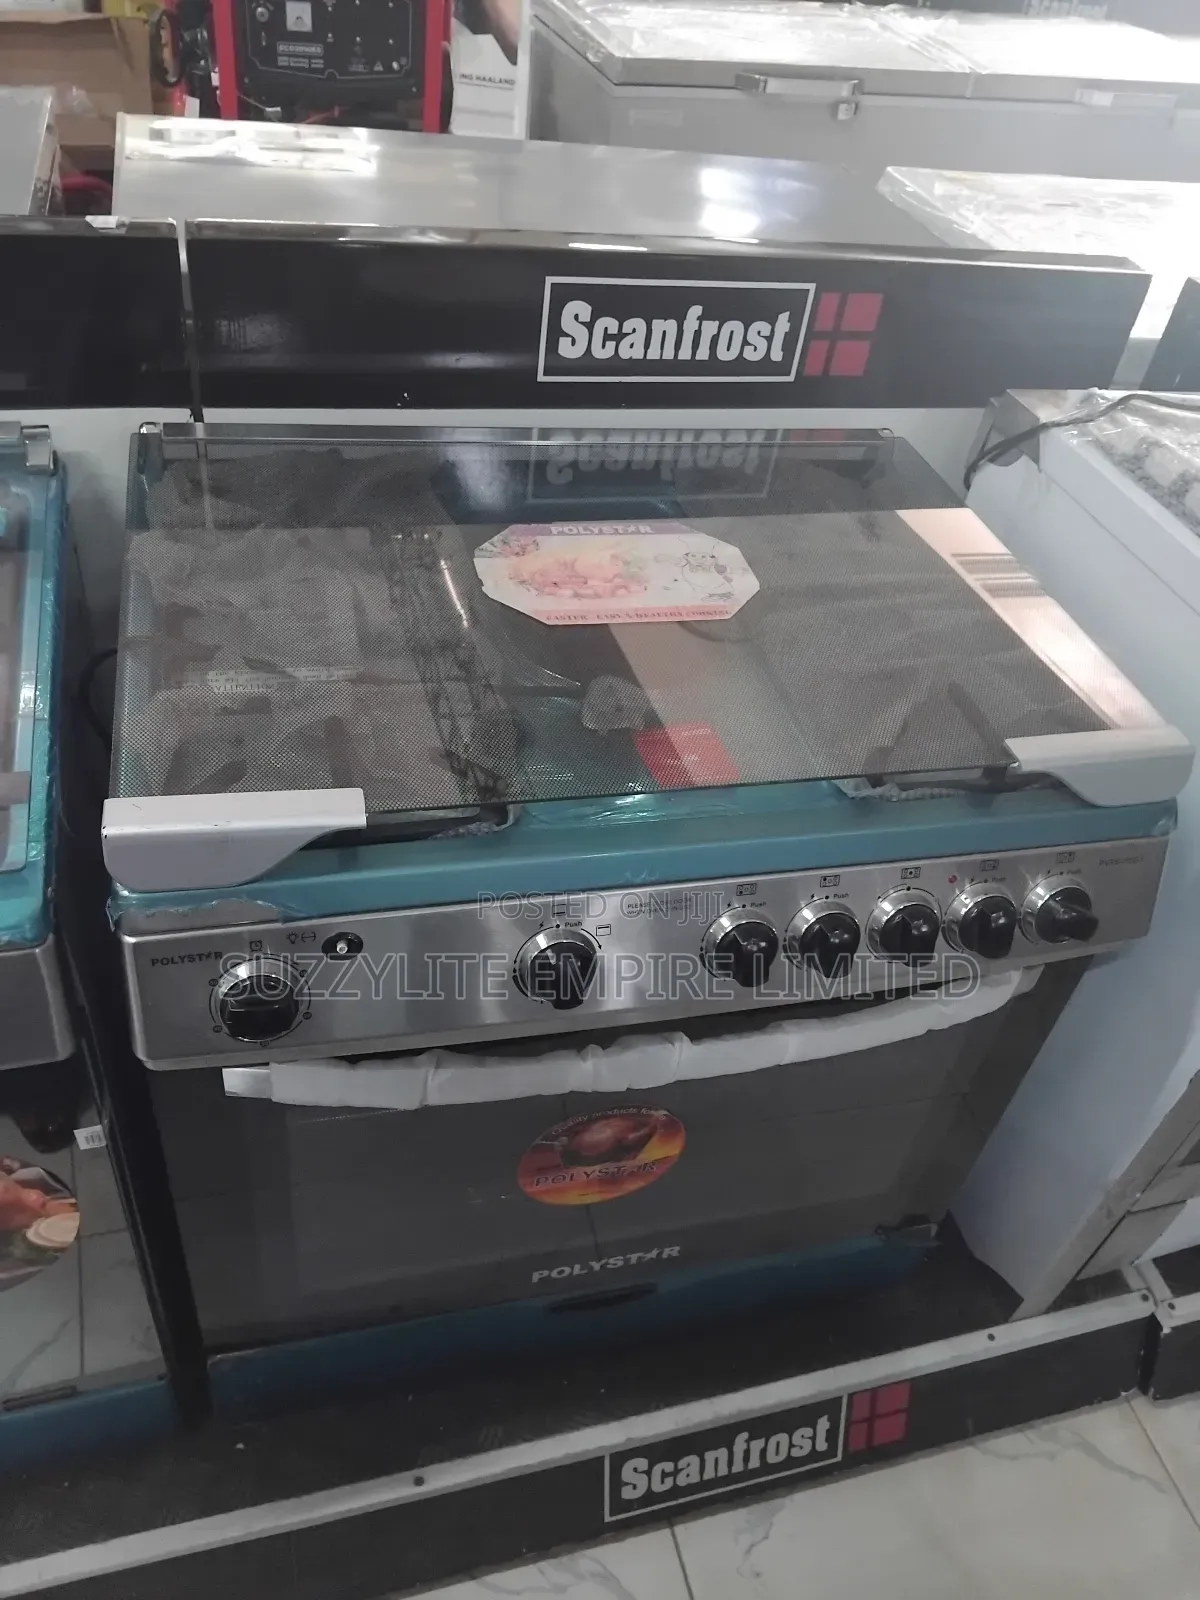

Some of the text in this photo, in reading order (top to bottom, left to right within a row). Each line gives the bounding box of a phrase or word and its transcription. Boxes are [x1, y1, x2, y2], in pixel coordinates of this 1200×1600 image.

[558, 300, 791, 362] Scanfrost
[564, 920, 583, 928] Push
[592, 1107, 638, 1118] products
[621, 1414, 831, 1500] Scanfrost
